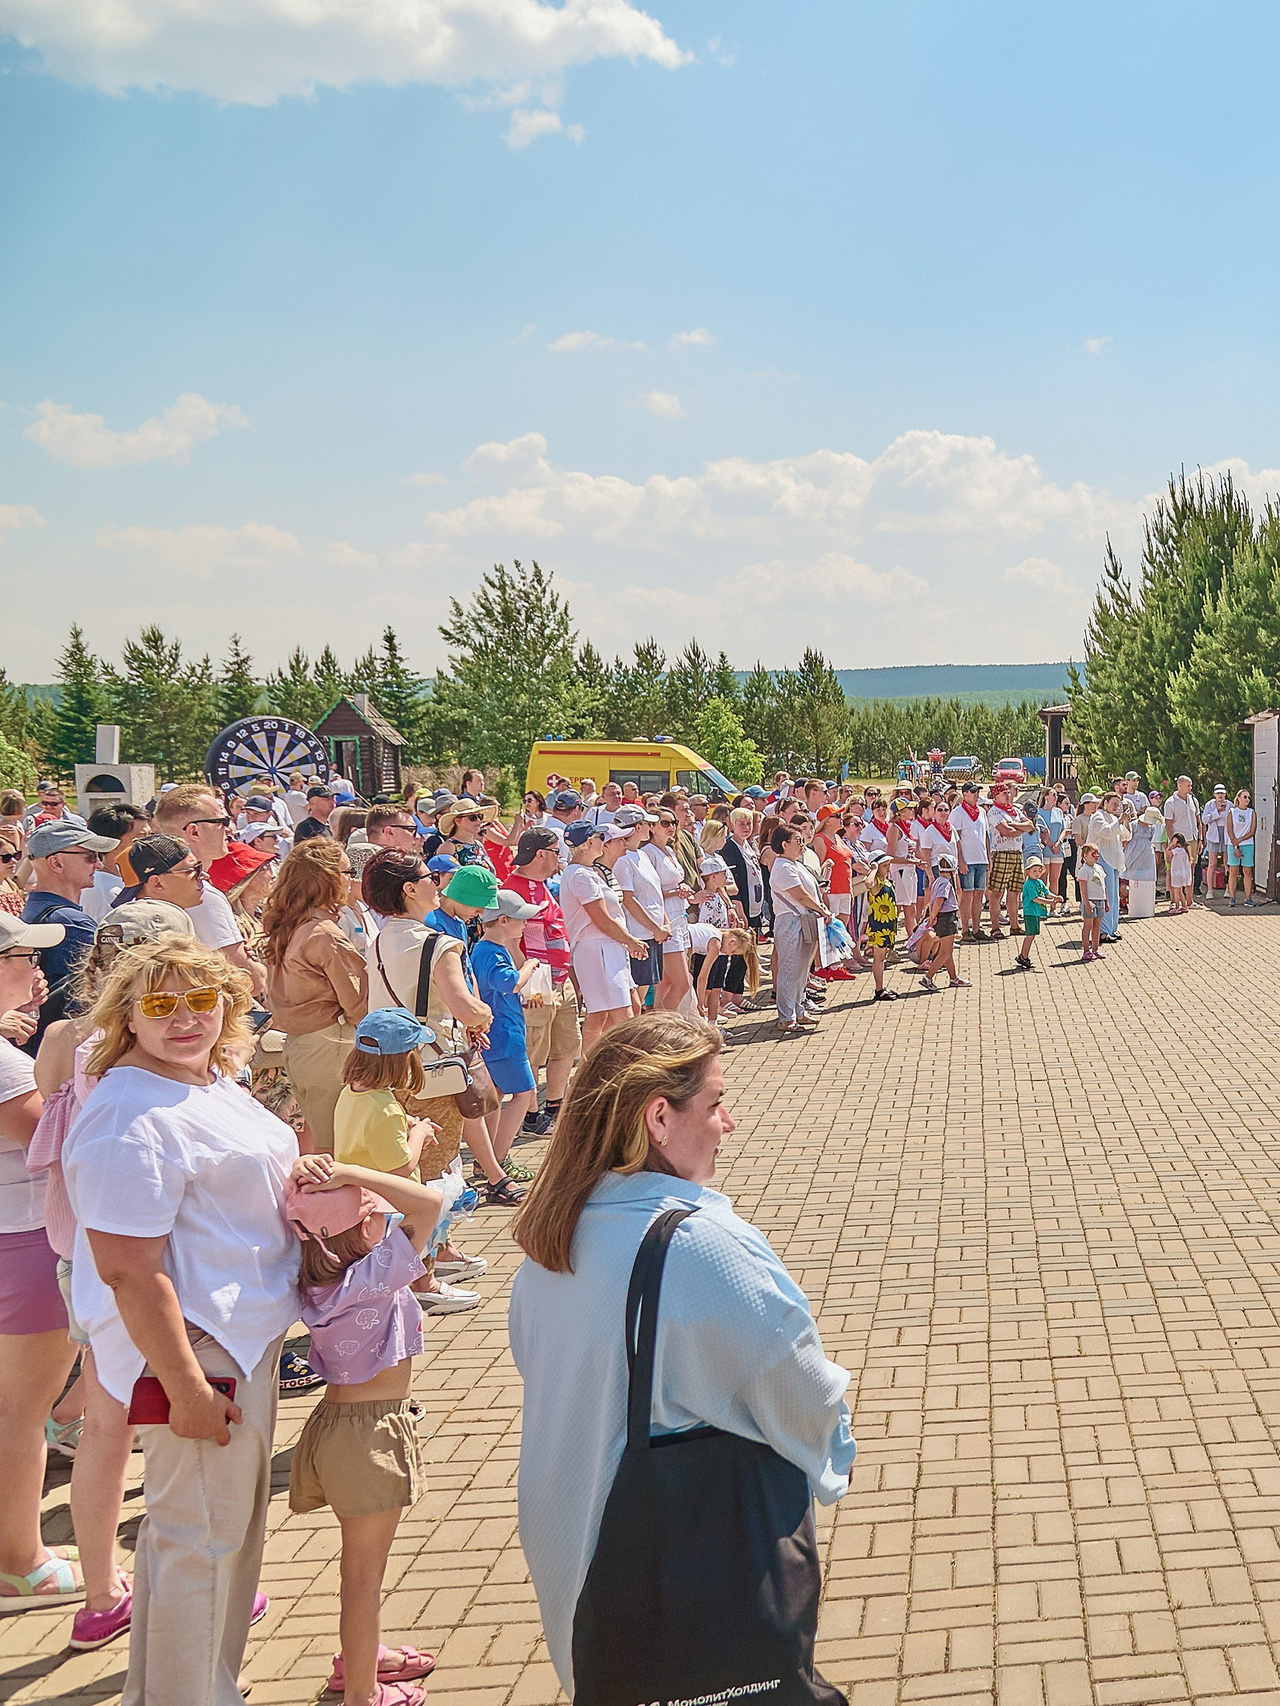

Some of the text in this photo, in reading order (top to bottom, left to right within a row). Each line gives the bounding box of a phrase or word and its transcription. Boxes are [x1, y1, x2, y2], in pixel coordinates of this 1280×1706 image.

[251, 723, 260, 731] 5
[264, 721, 278, 729] 20
[284, 722, 290, 731] 1
[235, 728, 249, 740] 12
[294, 728, 306, 739] 18
[226, 740, 236, 749] 9
[307, 739, 316, 748] 4
[219, 751, 230, 763] 14
[314, 749, 324, 761] 13
[218, 767, 227, 776] 11
[221, 781, 230, 790] 8
[667, 1679, 781, 1706] МонолитХолдинг
